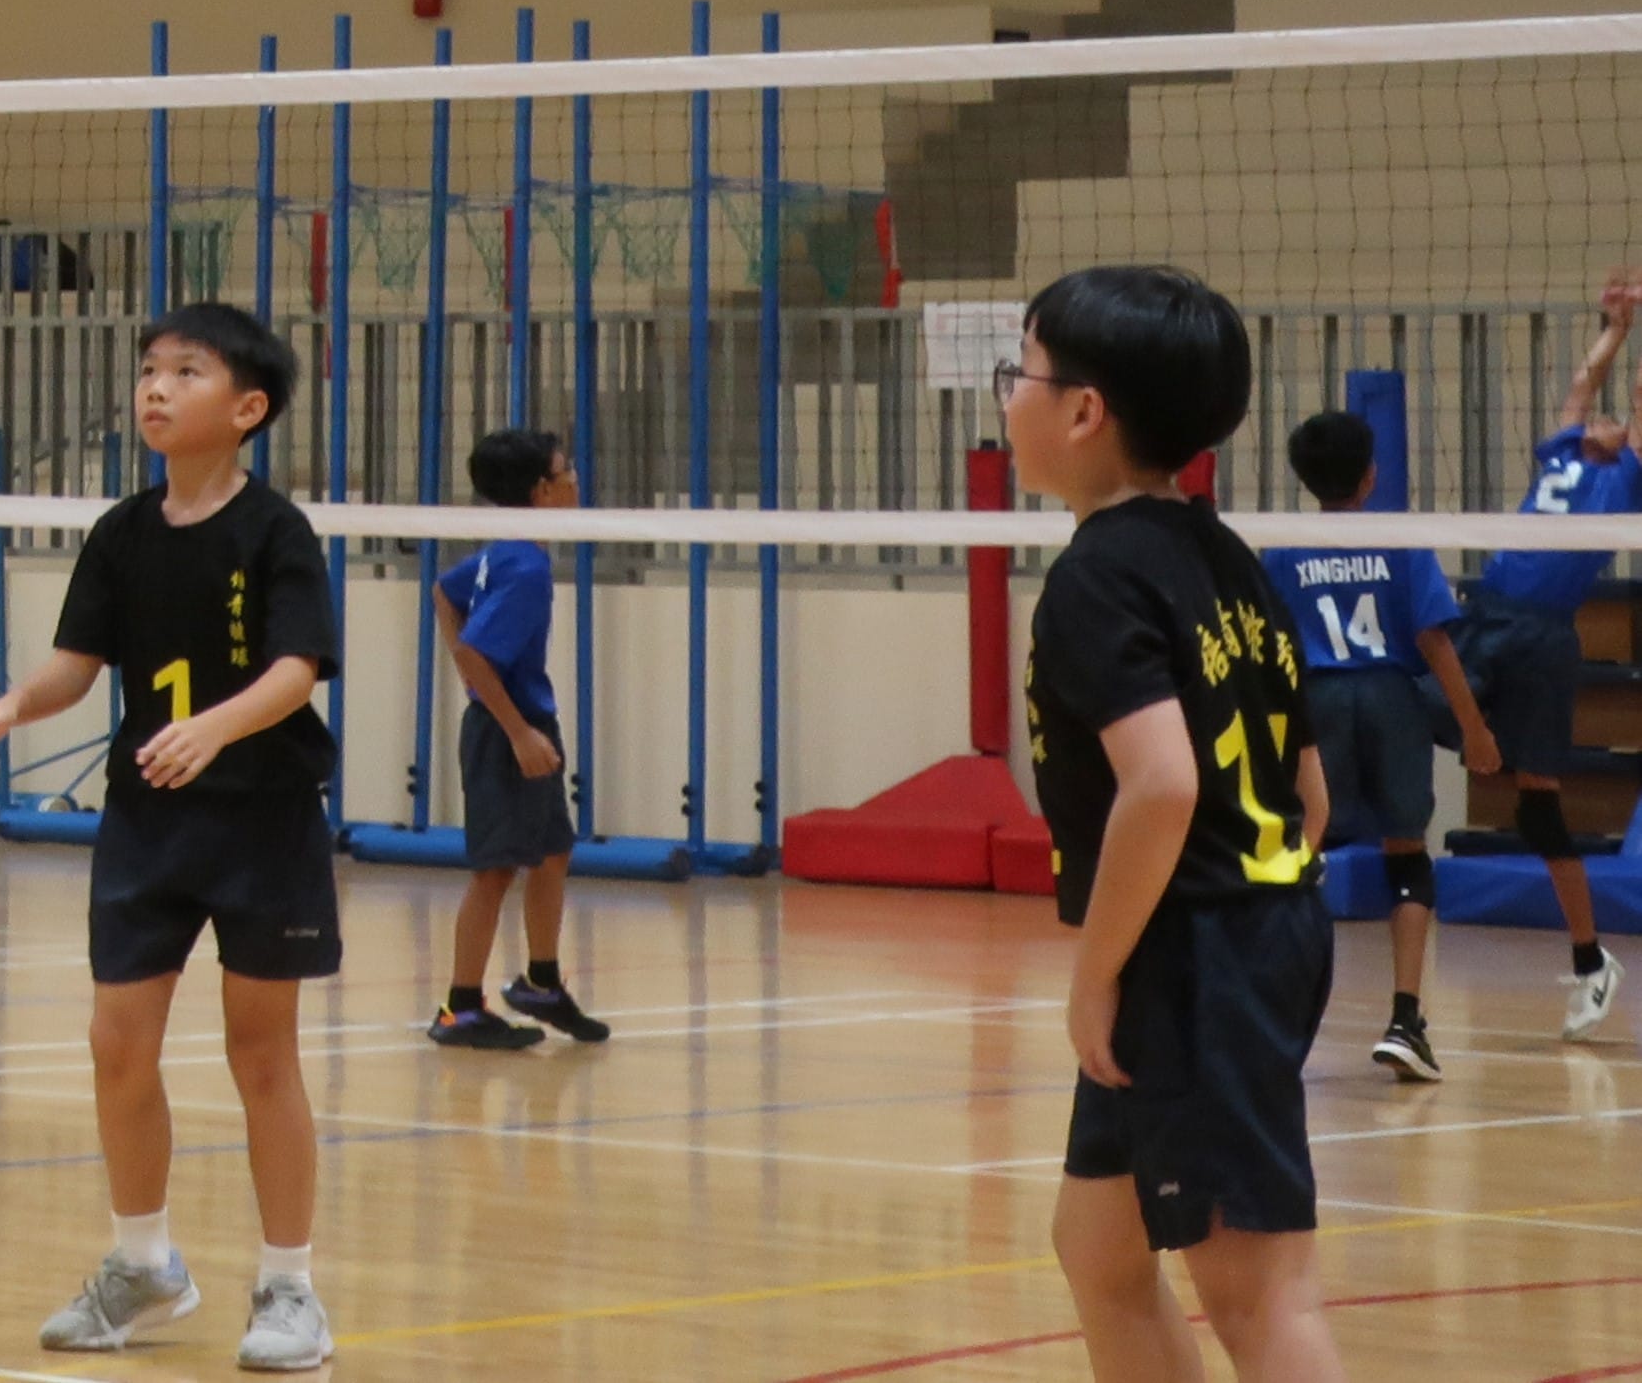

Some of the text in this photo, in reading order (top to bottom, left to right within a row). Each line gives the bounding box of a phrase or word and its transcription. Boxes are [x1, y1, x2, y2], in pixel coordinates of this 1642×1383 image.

[1536, 460, 1583, 514] 2
[1295, 554, 1391, 589] XINGHUA
[1316, 593, 1387, 662] 14
[153, 657, 192, 723] 1
